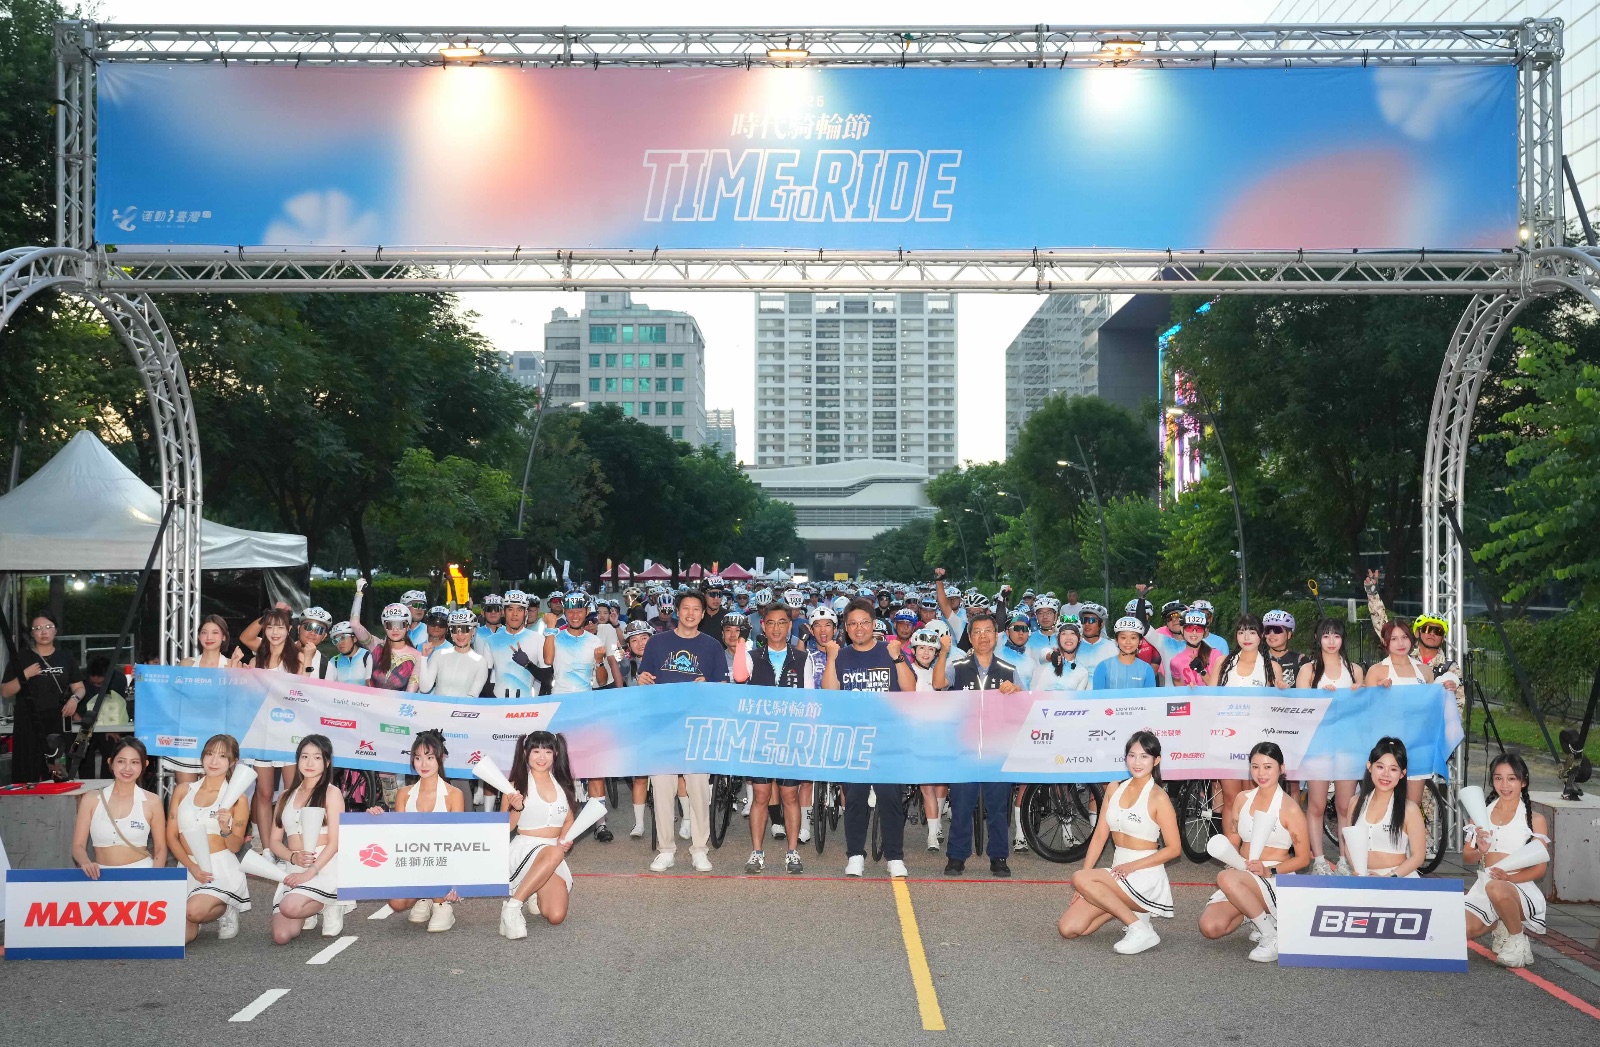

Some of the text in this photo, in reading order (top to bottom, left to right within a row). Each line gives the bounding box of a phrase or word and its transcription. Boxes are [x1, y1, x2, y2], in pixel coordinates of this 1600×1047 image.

[730, 112, 872, 141] 時代騎輪節
[643, 149, 963, 222] TIME TO RIDE
[1187, 615, 1204, 624] 1327
[842, 670, 889, 684] CYCLING
[737, 698, 823, 718] 時代騎輪節
[1054, 709, 1089, 717] GIANT
[1270, 706, 1316, 715] WHEELER
[271, 711, 294, 720] KMC
[505, 711, 539, 719] MAXXIS
[684, 716, 877, 771] TIME TO RIDE
[355, 749, 377, 757] KENDA
[395, 842, 491, 853] LION TRAVEL
[394, 856, 448, 867] 雄獅旅遊
[24, 900, 168, 927] MAXXIS
[1318, 910, 1423, 935] BETO
